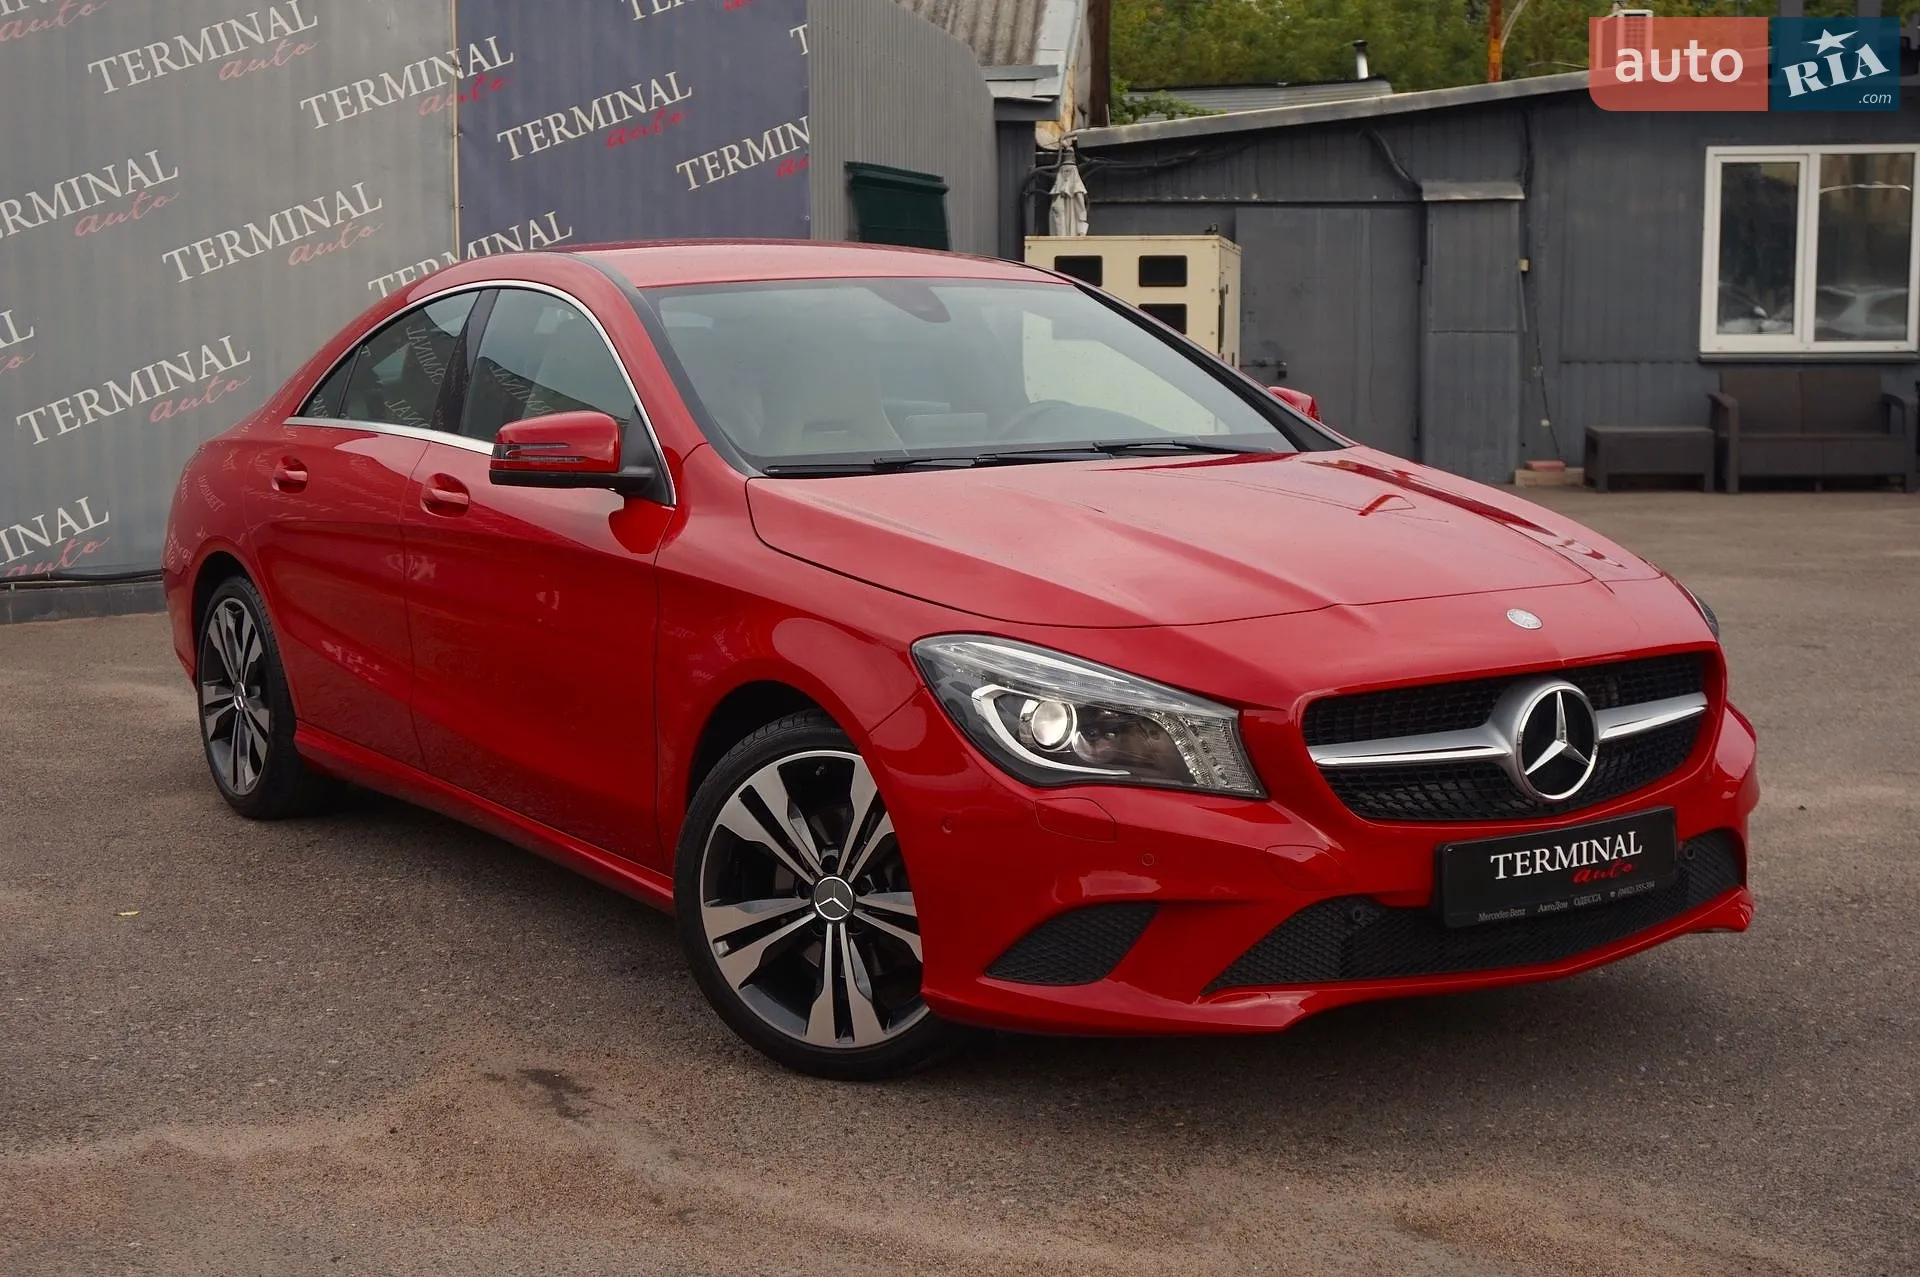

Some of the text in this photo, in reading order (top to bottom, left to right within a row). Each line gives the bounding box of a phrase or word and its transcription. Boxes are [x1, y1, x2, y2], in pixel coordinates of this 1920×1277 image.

[88, 0, 318, 95] TERMINAL
[218, 38, 318, 81] auto
[300, 36, 514, 129] TERMINAL
[497, 71, 692, 161] TERMINAL
[0, 149, 179, 239] RMINAL
[75, 190, 179, 237] auto
[162, 182, 382, 283] TERMINAL
[288, 221, 383, 266] auto
[16, 335, 251, 445] TERMINAL
[149, 374, 252, 423] auto
[0, 497, 110, 565] INAL
[1490, 831, 1643, 880] TERMINAL
[1573, 858, 1637, 883] auto
